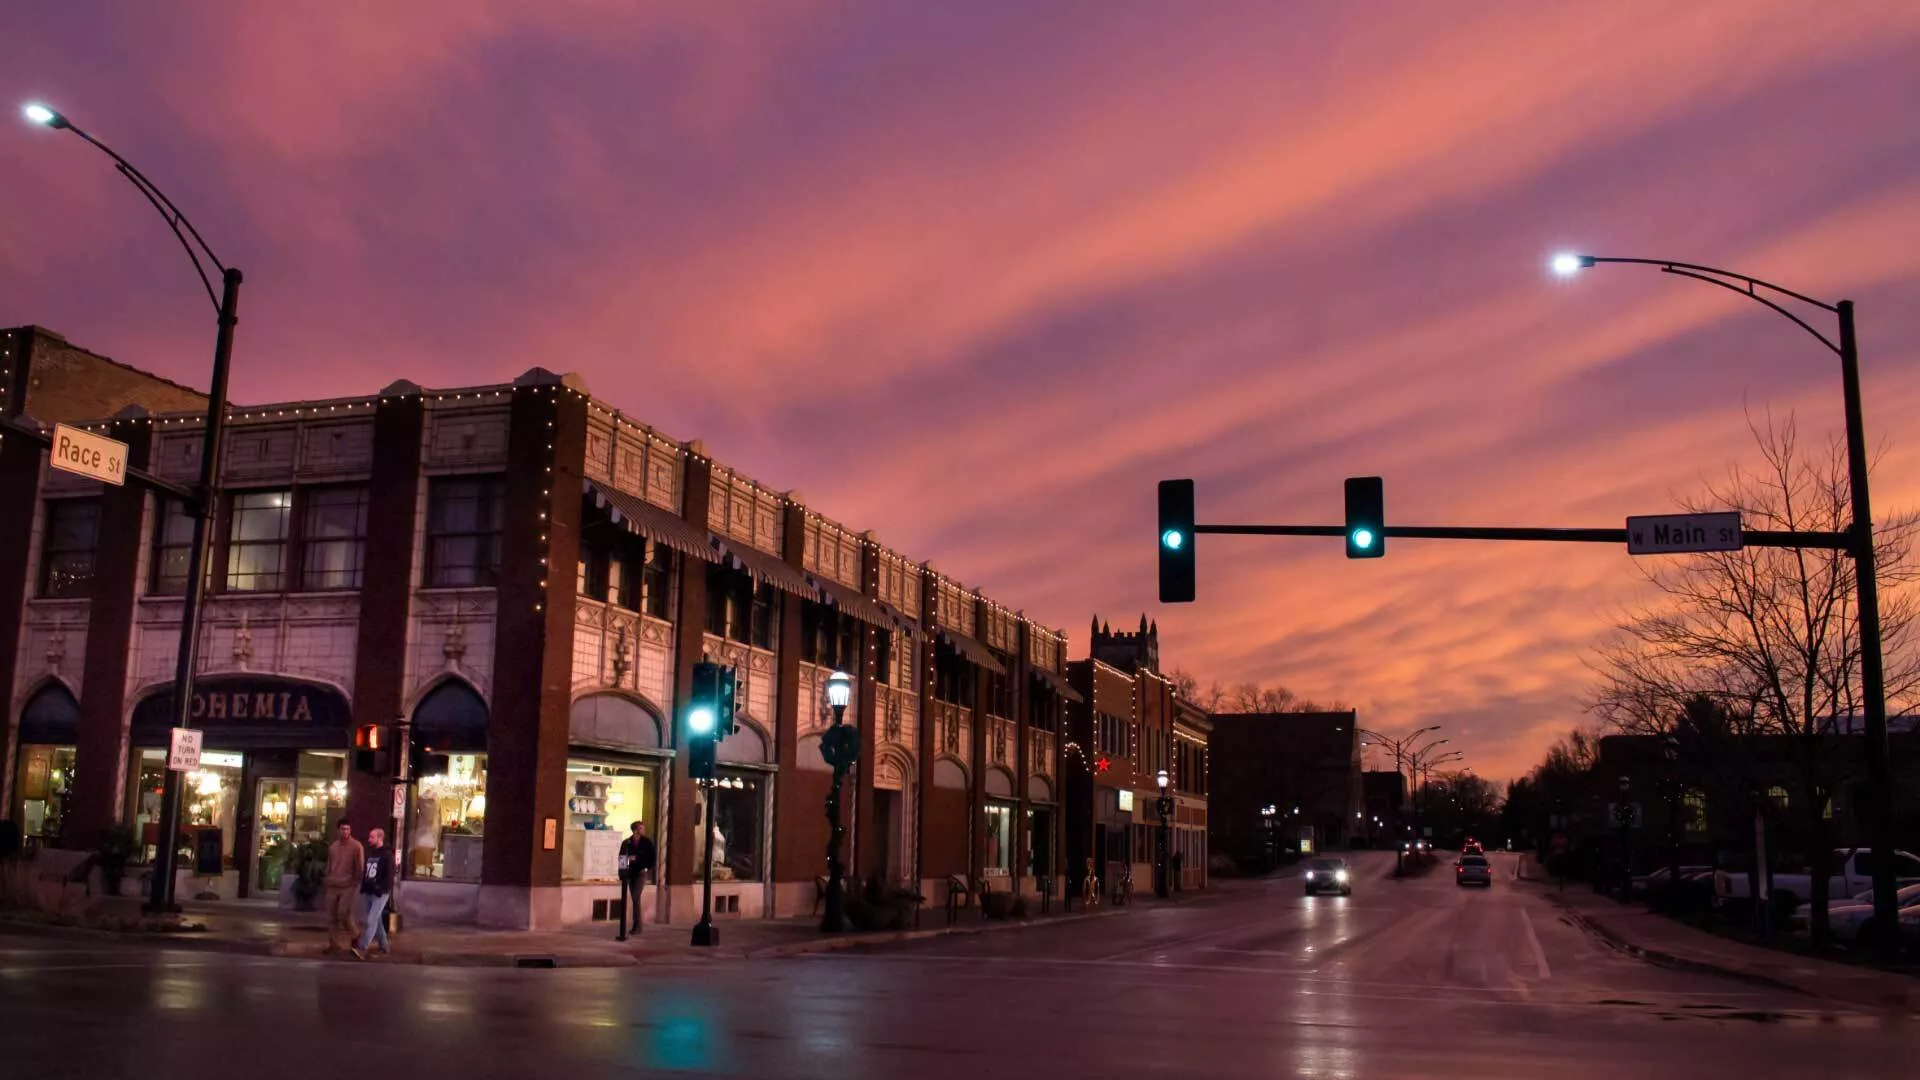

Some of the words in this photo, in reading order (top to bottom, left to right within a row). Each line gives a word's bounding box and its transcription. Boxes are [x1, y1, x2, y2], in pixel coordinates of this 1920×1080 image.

[59, 435, 101, 468] Race
[108, 456, 121, 474] St
[1632, 529, 1644, 545] W
[1654, 521, 1705, 545] Main
[1719, 527, 1734, 542] St
[191, 692, 313, 721] OHEMIA
[182, 735, 193, 744] NO
[178, 745, 196, 755] TURN
[173, 756, 182, 765] ON
[185, 757, 198, 767] RED
